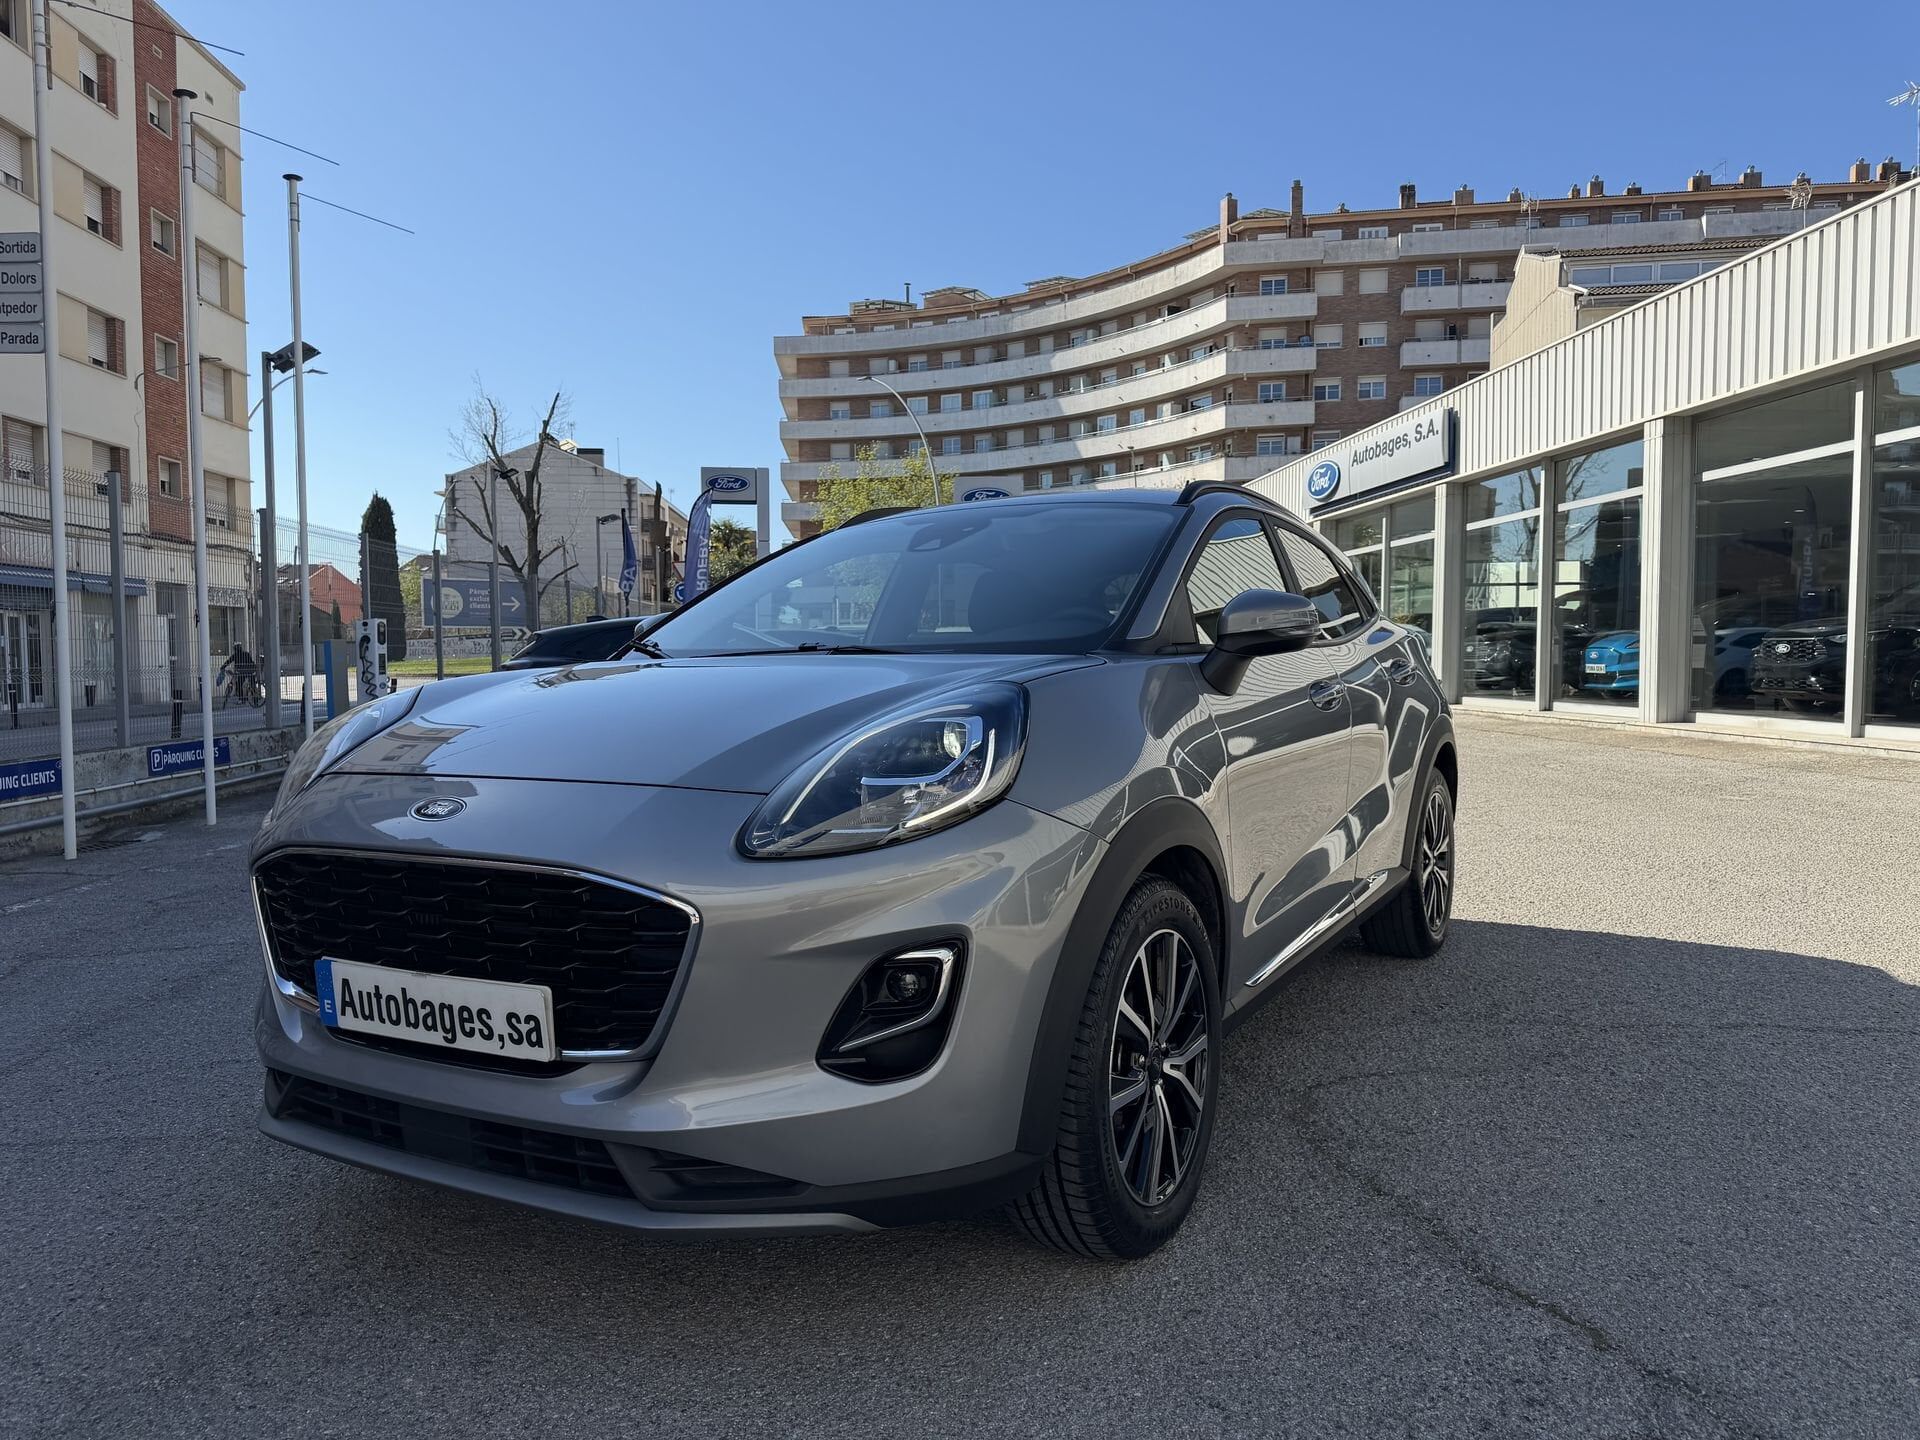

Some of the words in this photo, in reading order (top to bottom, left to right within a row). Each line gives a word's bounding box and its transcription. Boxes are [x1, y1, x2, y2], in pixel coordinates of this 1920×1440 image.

[0, 241, 37, 254] Sortida
[1, 272, 37, 285] Dolors
[0, 301, 38, 316] tpedor
[1, 332, 39, 345] Parada
[1351, 432, 1412, 467] Autobages,
[1414, 418, 1439, 443] S.A.
[1310, 467, 1332, 492] Ford
[163, 750, 196, 765] PÀRQUING
[20, 769, 56, 788] CLIENTS
[324, 1000, 333, 1013] E
[340, 977, 544, 1050] Autobages,sa
